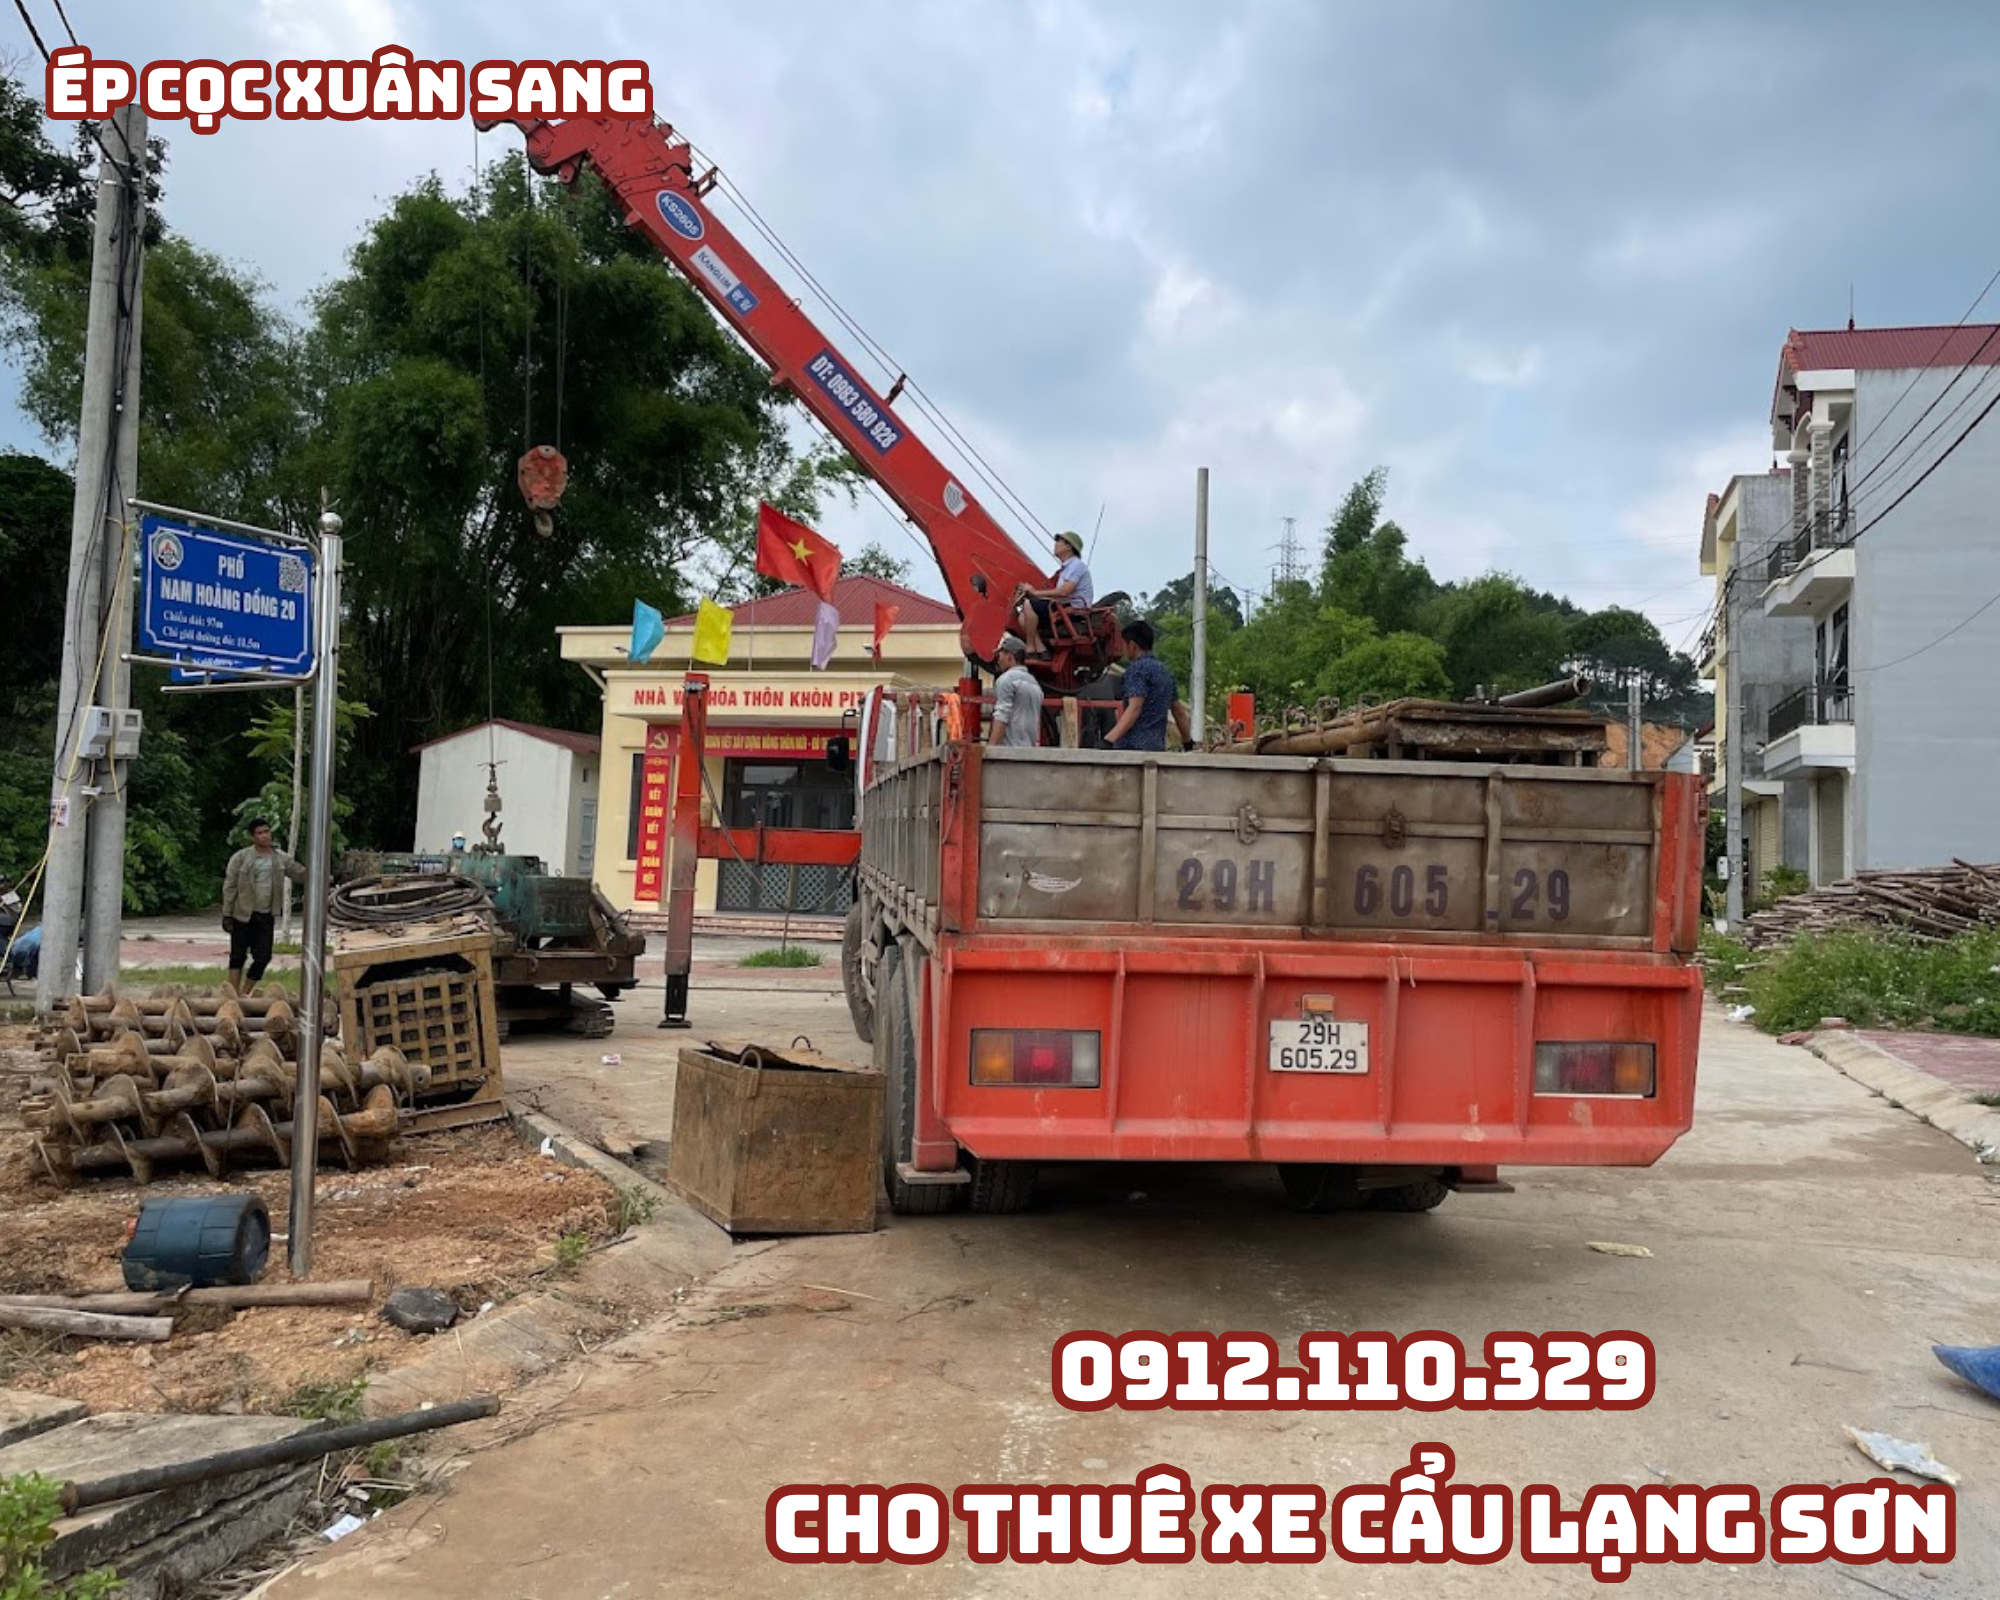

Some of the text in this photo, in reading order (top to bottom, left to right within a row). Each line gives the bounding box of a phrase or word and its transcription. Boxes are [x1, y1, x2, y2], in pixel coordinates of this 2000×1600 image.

[827, 373, 860, 408] 0983
[851, 399, 879, 428] 580
[869, 421, 898, 448] 928
[218, 552, 245, 580] PHỐ
[160, 576, 192, 605] NAM
[195, 581, 241, 612] HOÀNG
[280, 599, 296, 621] 20
[634, 685, 667, 706] NHÀ
[743, 685, 784, 707] THÔN
[790, 686, 833, 707] KHÒN
[1178, 857, 1275, 913] 29H
[1354, 863, 1448, 918] 605
[1298, 1022, 1341, 1045] 29H
[1280, 1047, 1357, 1070] 605.29
